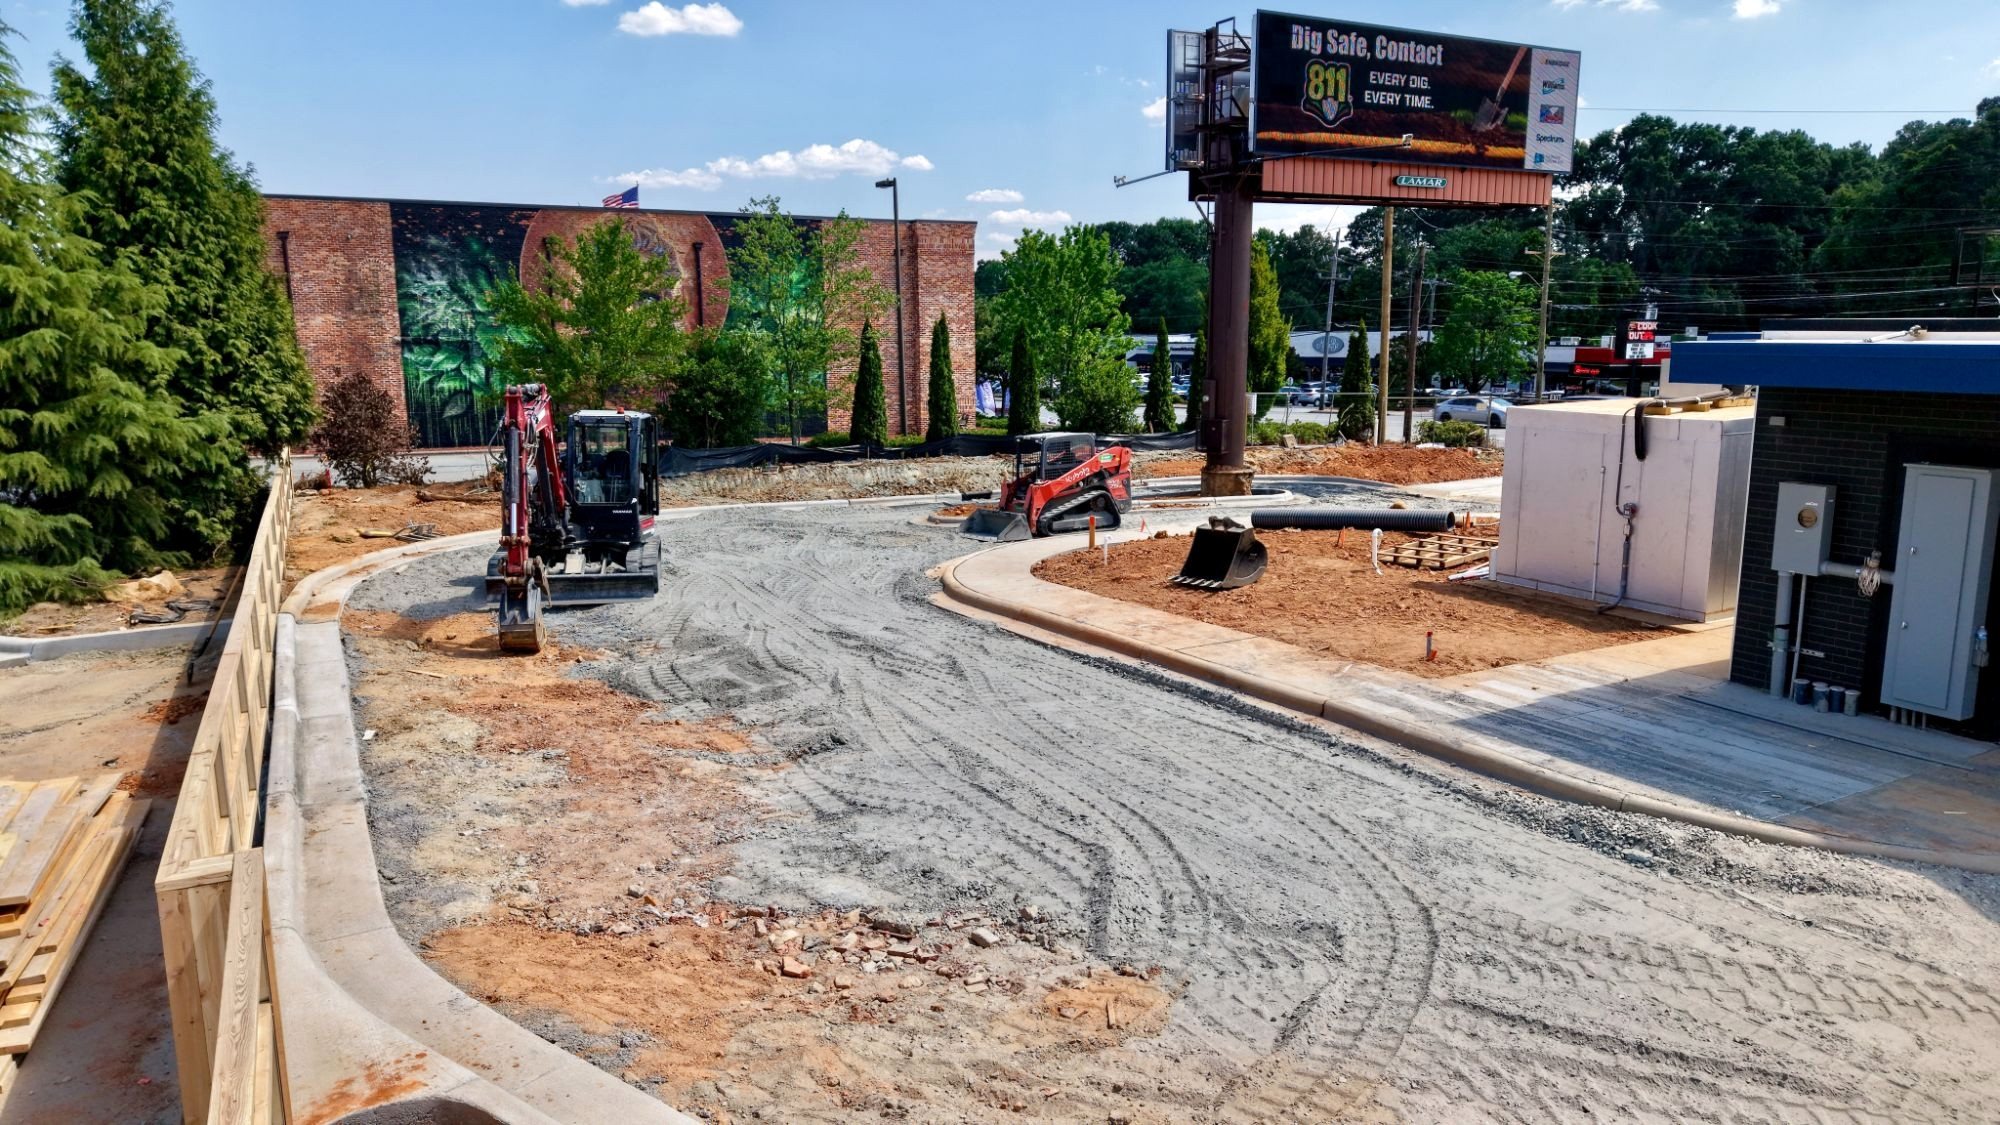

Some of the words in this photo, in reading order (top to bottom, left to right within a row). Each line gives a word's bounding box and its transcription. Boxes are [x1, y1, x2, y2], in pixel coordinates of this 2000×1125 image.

[1291, 24, 1322, 55] Dig
[1327, 28, 1371, 61] Safe,
[1375, 34, 1444, 66] Contact
[1308, 63, 1347, 103] 811
[1369, 71, 1407, 87] EVERY
[1409, 75, 1431, 89] DIG.
[1364, 90, 1401, 105] EVERY
[1404, 93, 1434, 109] TIME.
[1536, 133, 1564, 144] Spectrum
[1401, 176, 1443, 187] LAMAR
[1637, 321, 1658, 330] COOK
[1628, 331, 1644, 340] OUT
[1065, 466, 1090, 483] Kubota
